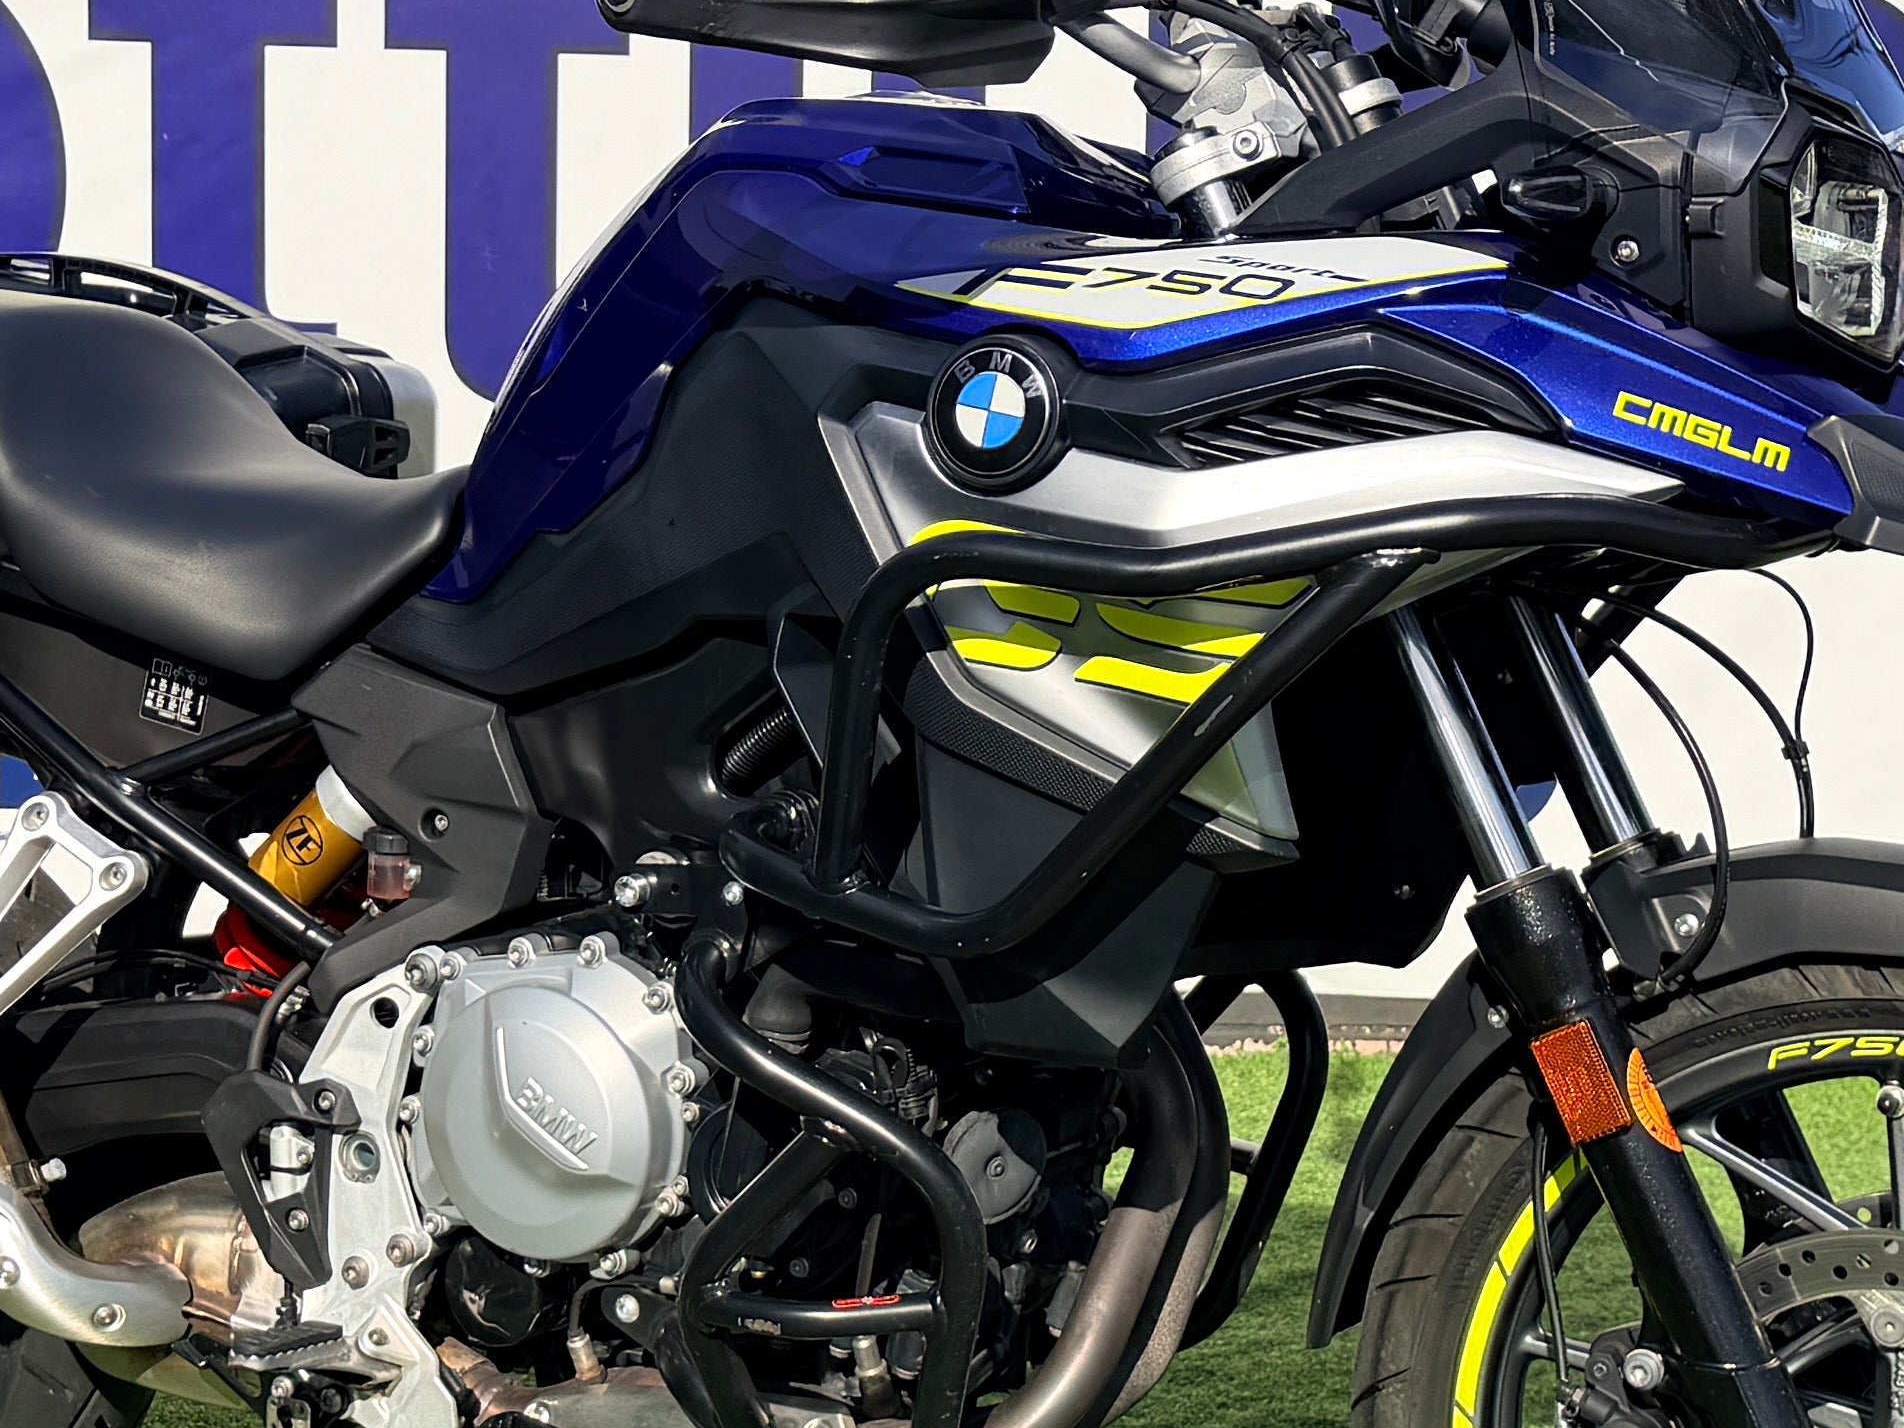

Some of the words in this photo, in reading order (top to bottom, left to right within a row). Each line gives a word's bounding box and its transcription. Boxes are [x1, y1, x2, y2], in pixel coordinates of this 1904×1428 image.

[953, 265, 1296, 301] F750
[1198, 255, 1370, 283] Sport
[954, 351, 1045, 400] BMW
[1612, 390, 1791, 472] CMGLM
[516, 1076, 598, 1156] BMW
